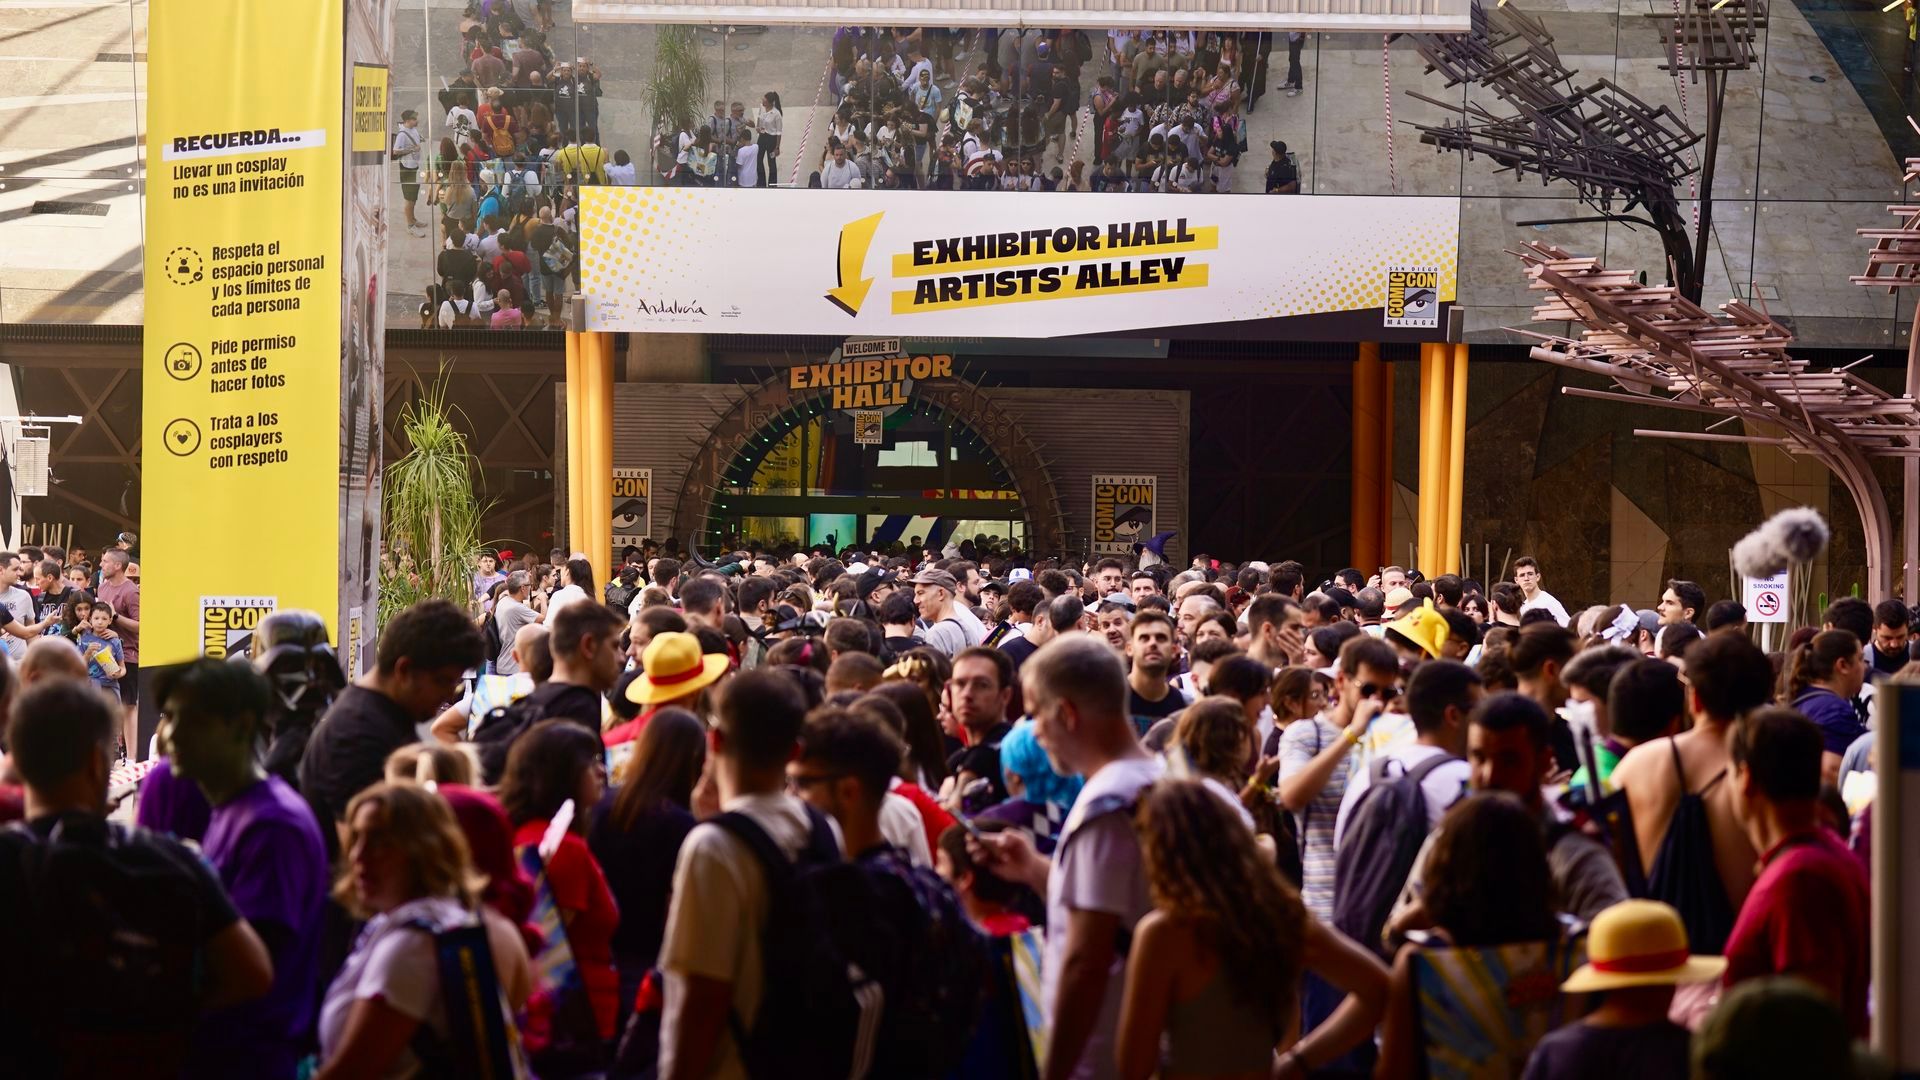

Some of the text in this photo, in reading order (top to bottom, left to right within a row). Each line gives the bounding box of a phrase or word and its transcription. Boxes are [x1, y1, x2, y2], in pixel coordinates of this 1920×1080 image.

[173, 128, 301, 153] RECUERDA...
[173, 157, 287, 181] Llevar un cosplay
[173, 172, 304, 199] no es una invitación
[212, 240, 280, 261] Respeta el
[913, 218, 1195, 266] EXHIBITOR HALL
[212, 255, 324, 280] espacio personal
[211, 276, 311, 300] y los límites de
[913, 257, 1186, 305] ARTISTS' ALLEY
[1406, 272, 1437, 288] CON
[1388, 272, 1406, 317] COMIC
[211, 297, 300, 318] cada persona
[636, 299, 708, 316] Andalucía
[211, 334, 296, 355] Pide permiso
[846, 340, 898, 354] WELCOME TO
[211, 356, 267, 374] antes de
[790, 355, 952, 389] EXHIBITOR
[211, 373, 285, 393] hacer fotos
[832, 383, 908, 409] HALL
[210, 412, 278, 431] Trata a los
[865, 415, 881, 423] CON
[210, 431, 283, 450] cosplayers
[210, 448, 289, 469] con respeto
[612, 478, 648, 497] CON
[1116, 485, 1152, 504] CON
[1095, 485, 1115, 542] COMIC
[205, 607, 227, 660] OMIC
